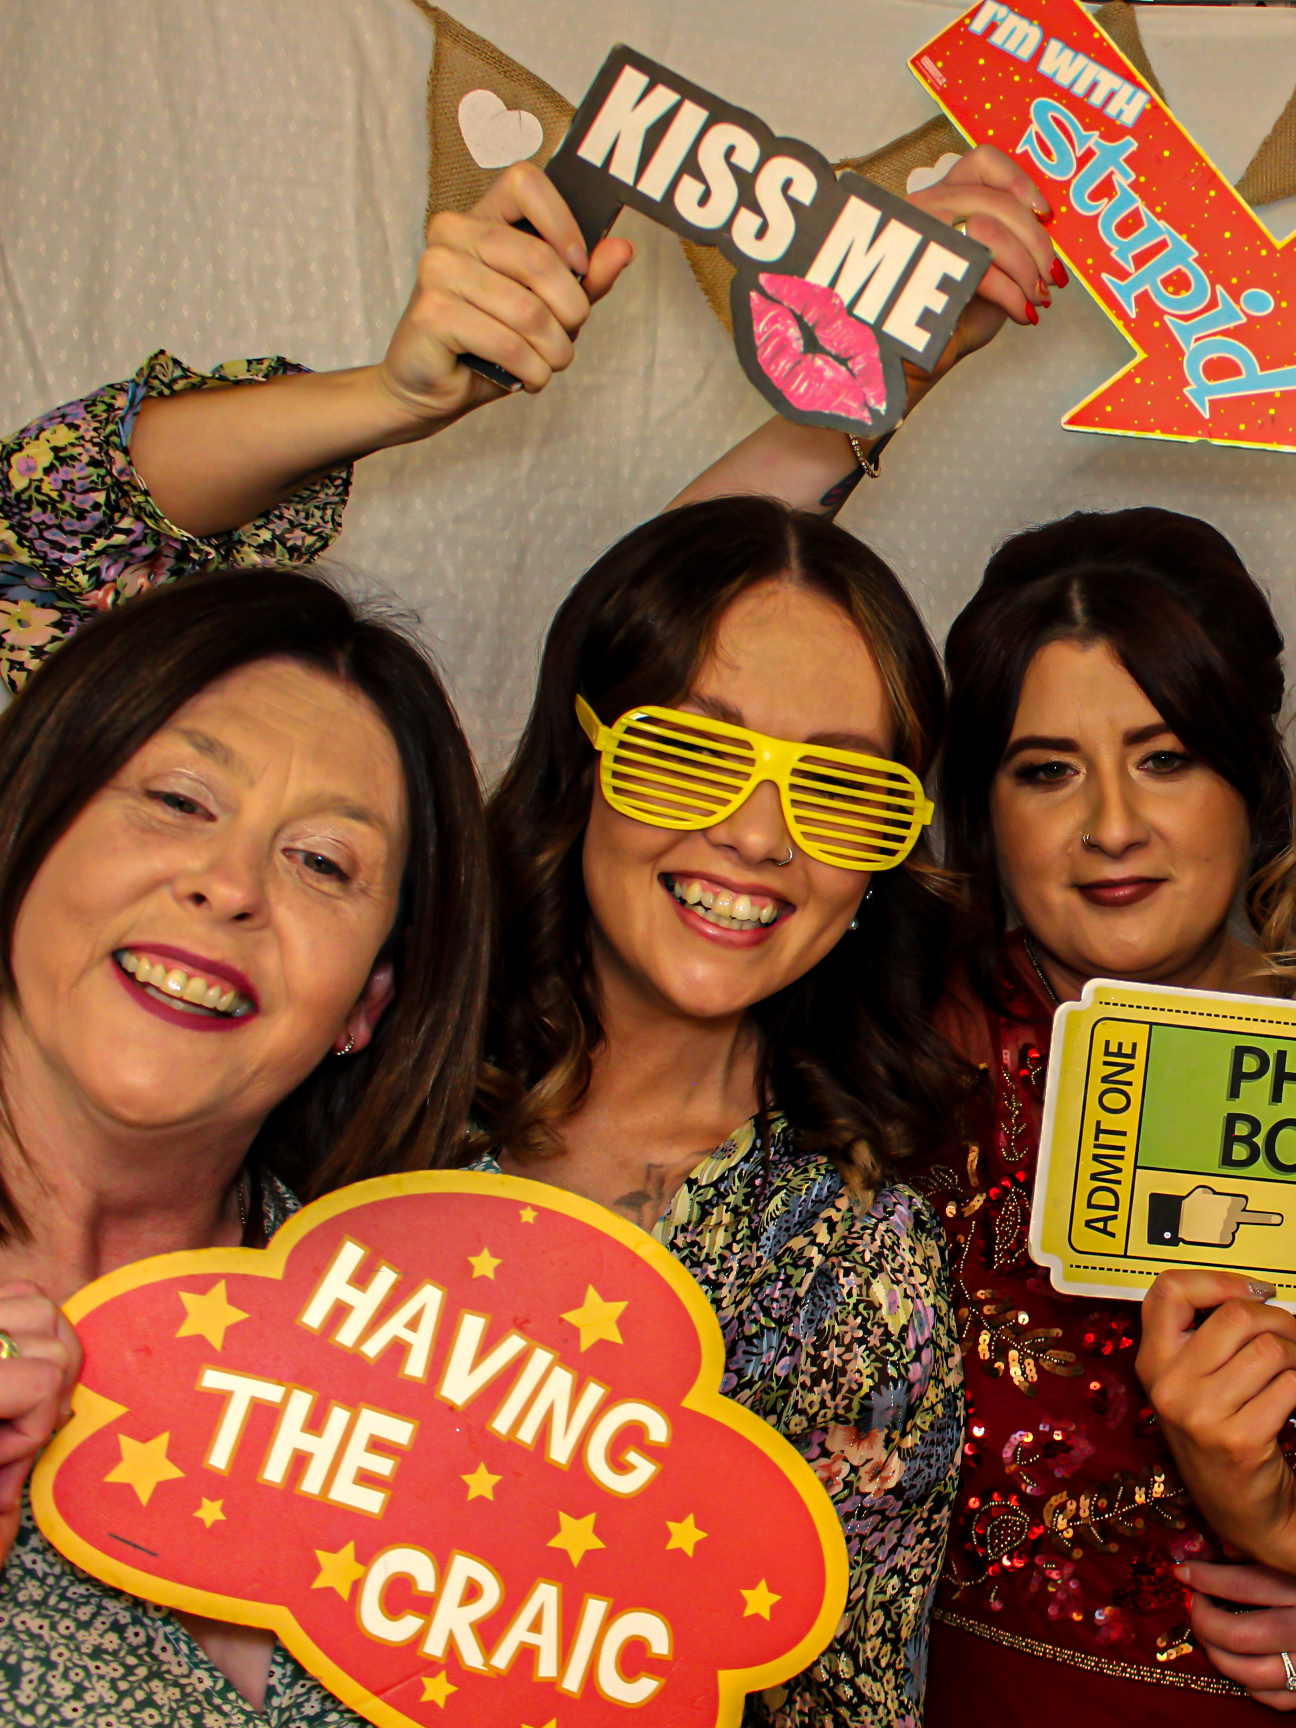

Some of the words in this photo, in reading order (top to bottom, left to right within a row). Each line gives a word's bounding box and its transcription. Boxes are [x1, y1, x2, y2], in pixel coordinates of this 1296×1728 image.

[1037, 37, 1150, 128] WITH
[577, 65, 817, 264] KISS
[805, 196, 969, 354] ME
[1098, 1039, 1137, 1115] ONE
[1085, 1119, 1128, 1239] ADMIT
[198, 1366, 420, 1518] THE
[298, 1236, 671, 1498] HAVING
[357, 1544, 673, 1706] CRAIC
